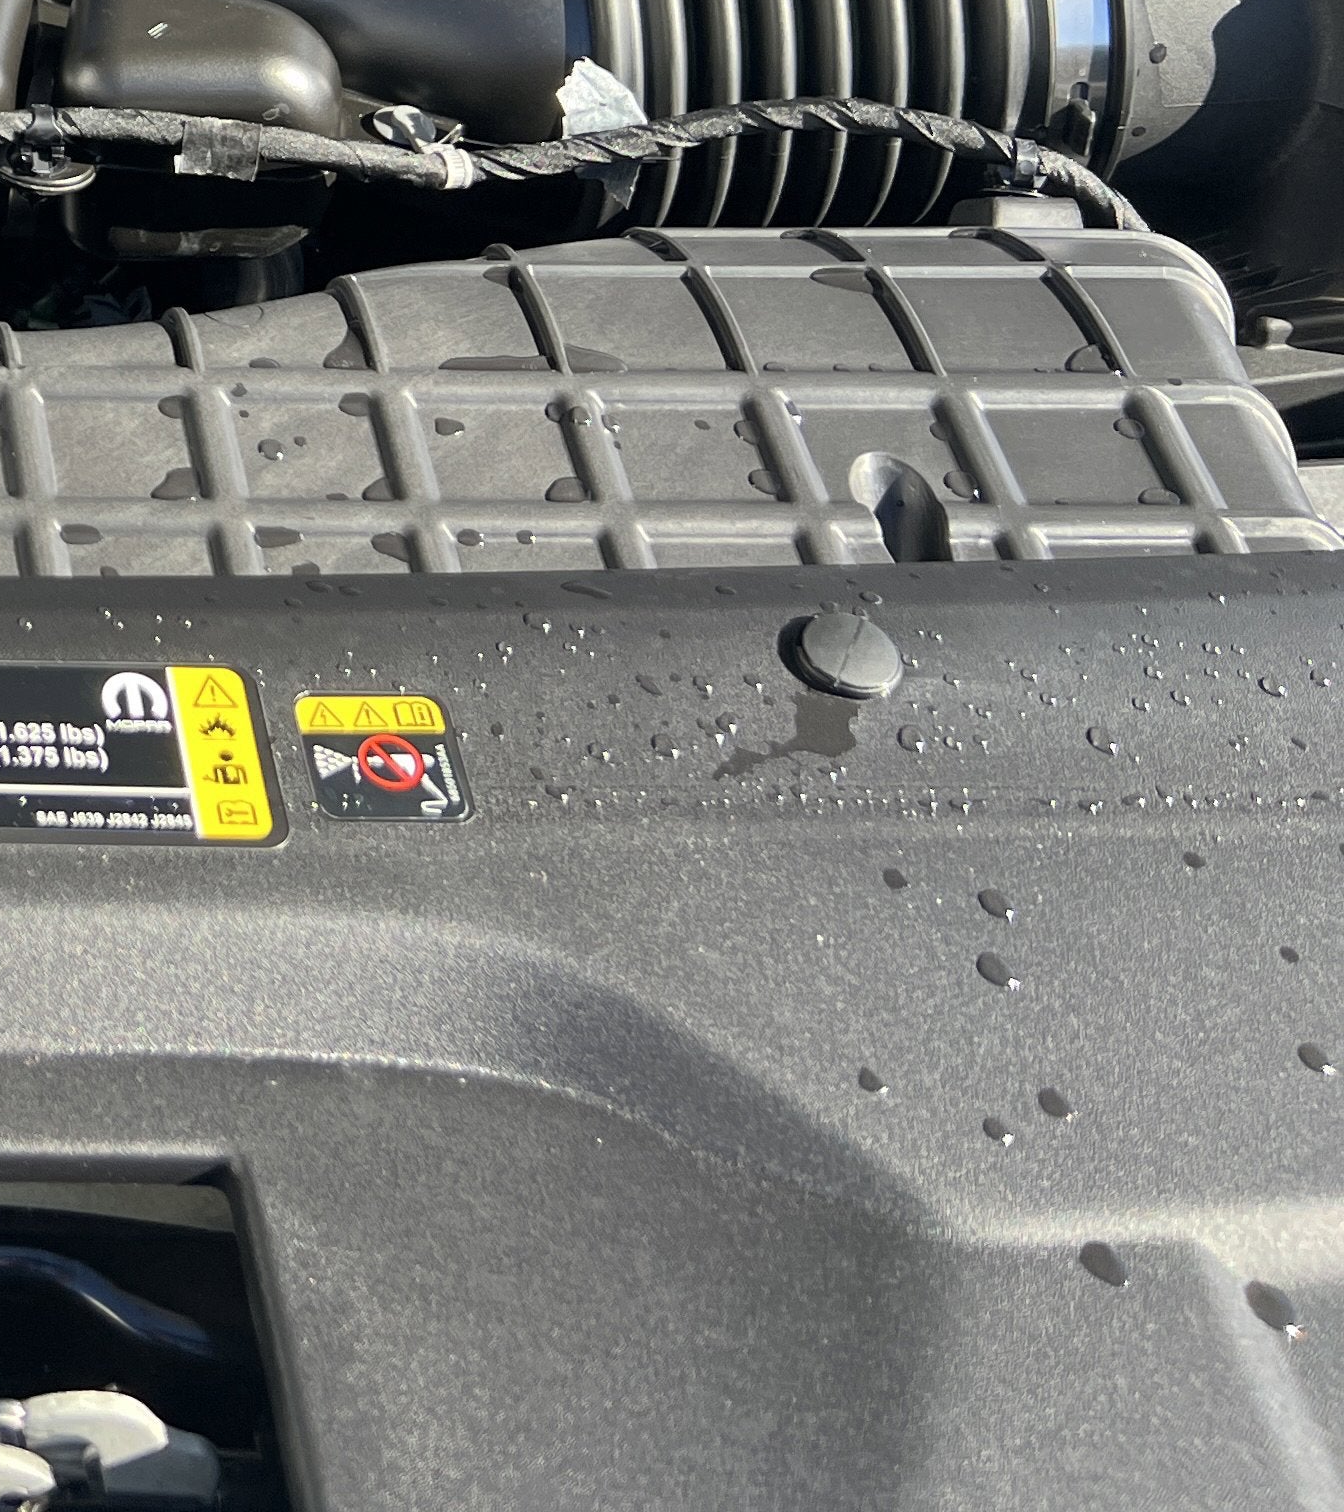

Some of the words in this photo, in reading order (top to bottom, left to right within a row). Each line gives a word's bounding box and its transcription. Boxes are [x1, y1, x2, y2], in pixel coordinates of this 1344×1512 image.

[59, 722, 105, 749] lbs)
[63, 746, 110, 774] lbs)
[35, 810, 69, 828] SAE
